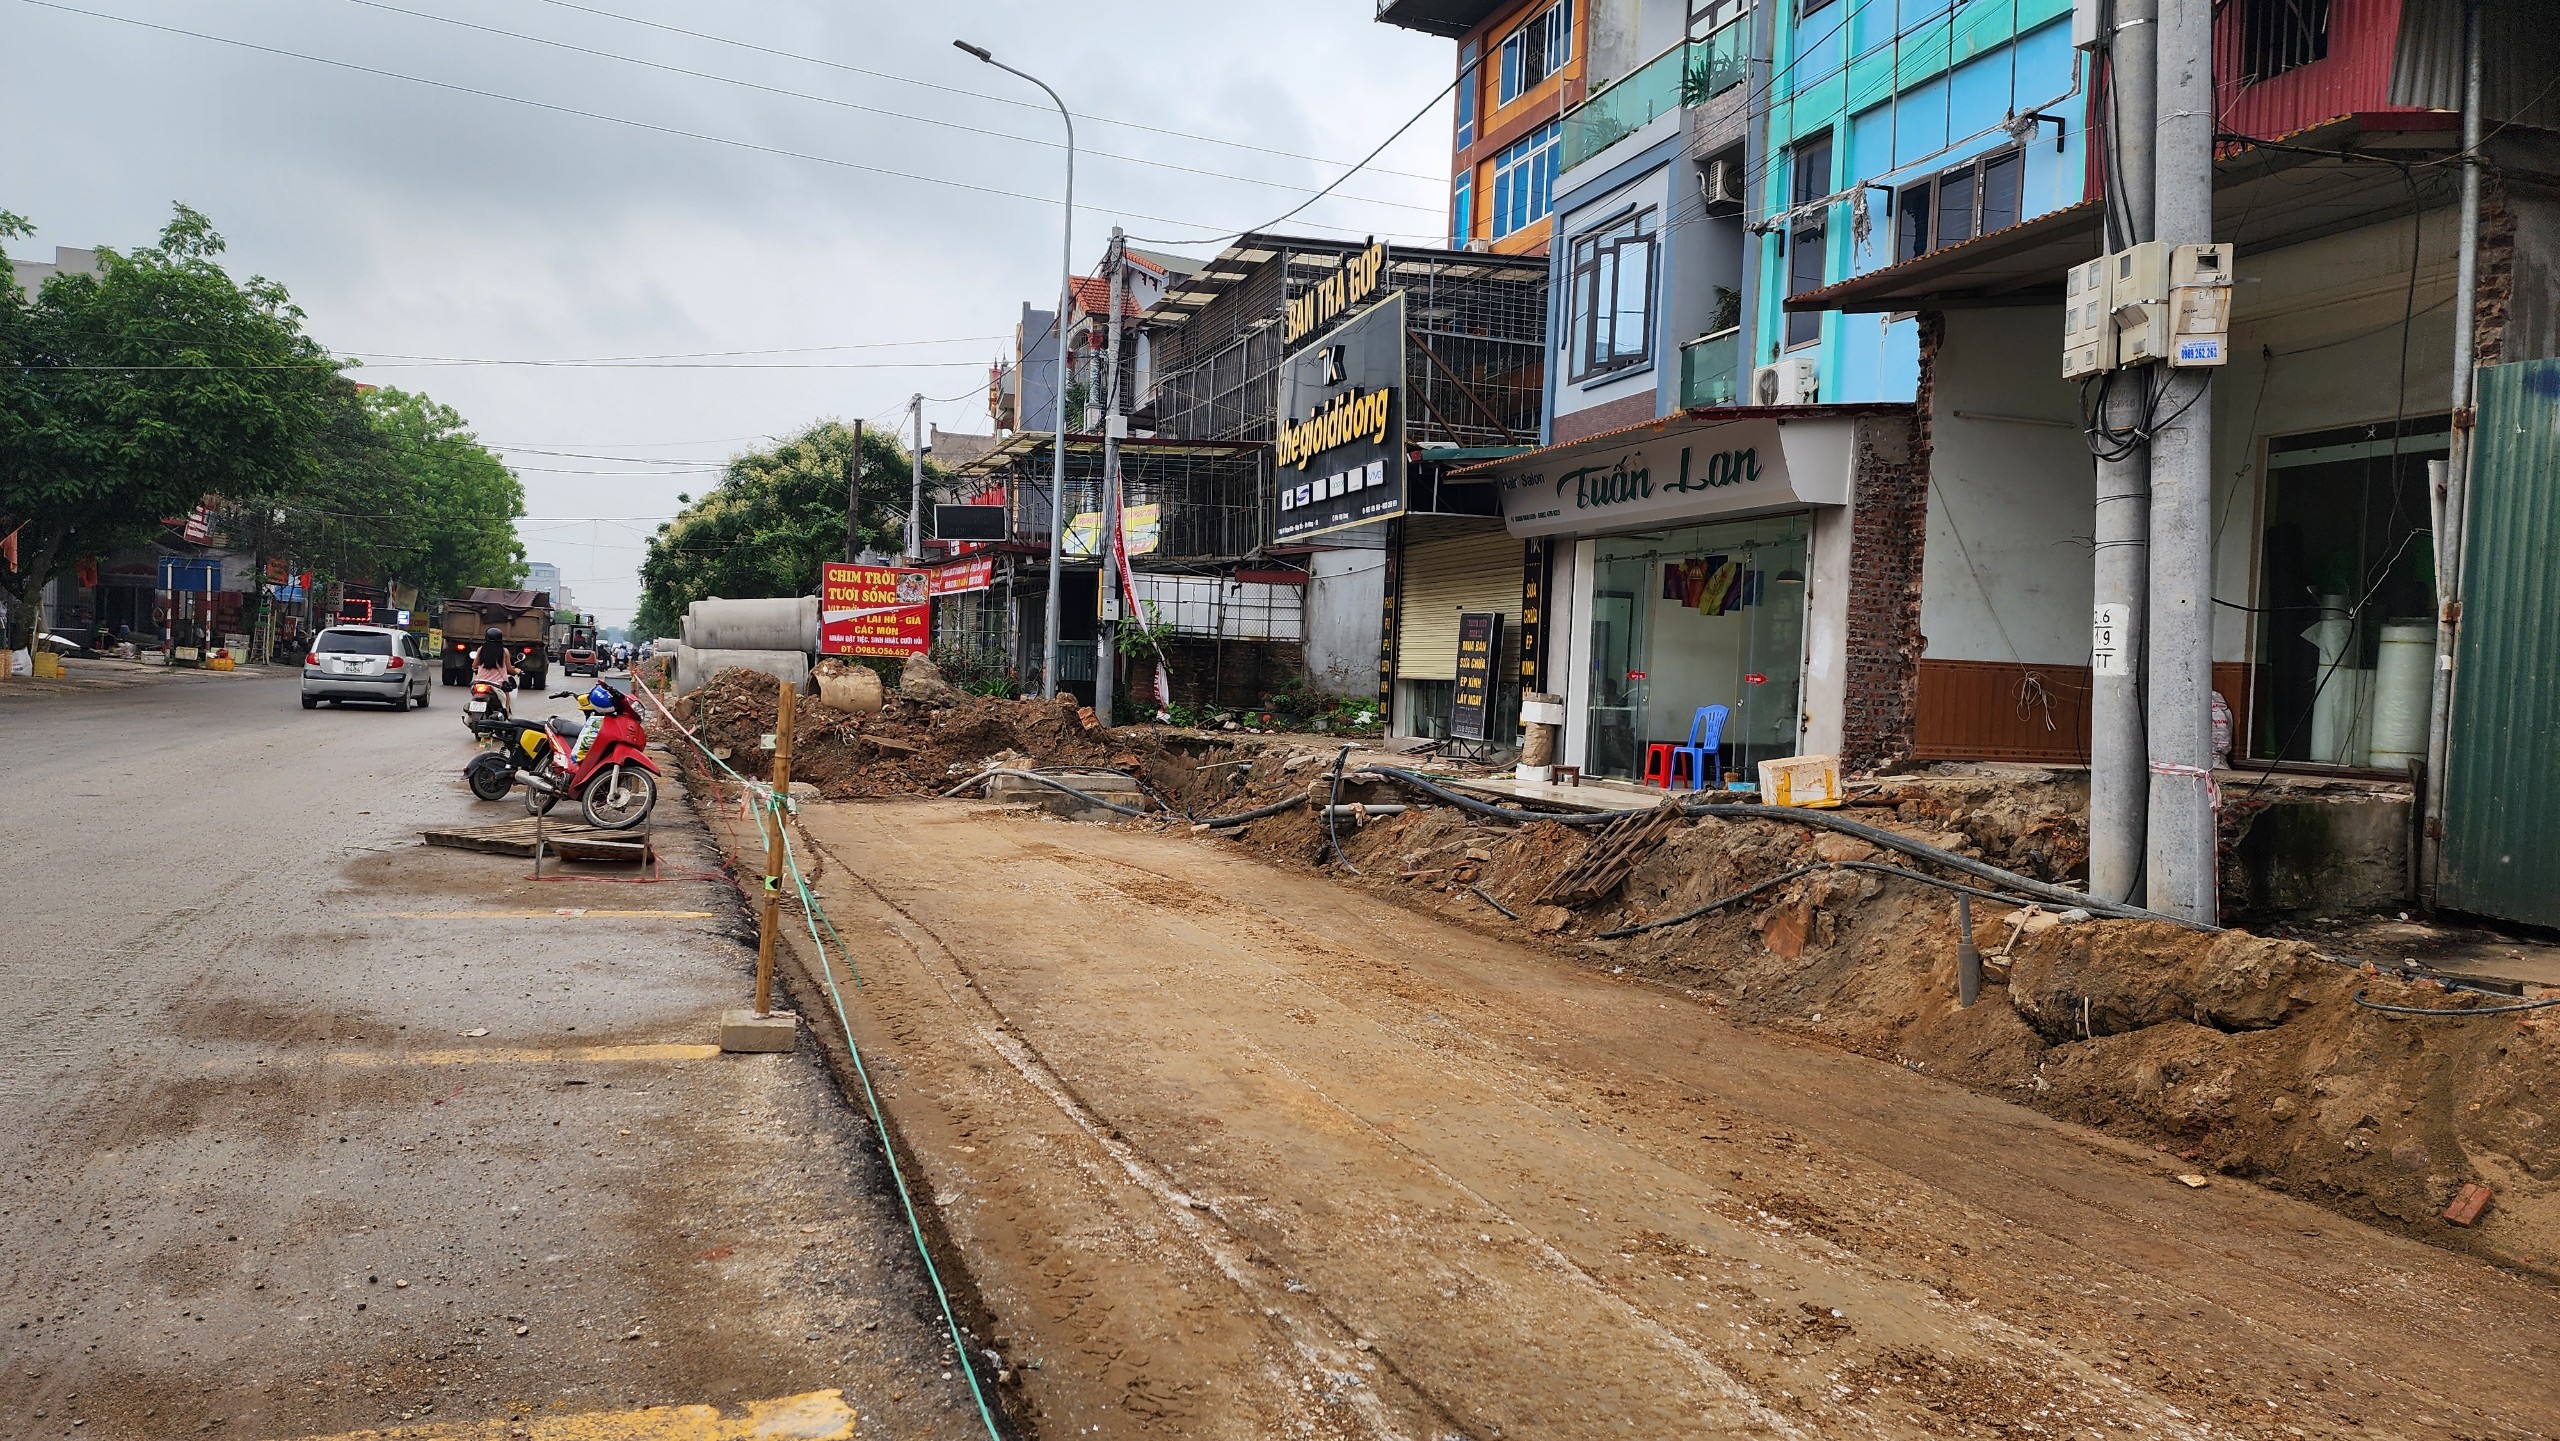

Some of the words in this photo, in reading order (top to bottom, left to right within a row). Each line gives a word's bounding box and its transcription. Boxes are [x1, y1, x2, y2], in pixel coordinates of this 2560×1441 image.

[1288, 284, 1315, 345] BÁN
[1348, 234, 1384, 304] GÓP
[1278, 387, 1390, 471] thegioididong
[1367, 470, 1382, 481] vivo
[1501, 476, 1518, 491] Hair
[1520, 471, 1546, 488] Salon
[1556, 454, 1656, 510] Tuấn
[1662, 446, 1764, 494] Lan
[828, 569, 862, 583] CHIM
[864, 569, 896, 586] TRỜI
[828, 586, 860, 602] TƯƠI
[861, 585, 896, 604] SỐNG
[1526, 578, 1538, 599] SỬA
[866, 615, 882, 624] LAI
[1523, 606, 1538, 625] CHỮA
[854, 625, 874, 635] CÁC
[876, 626, 899, 636] MÓN
[870, 636, 884, 644] SINH
[1462, 640, 1475, 652] MUA
[1475, 638, 1487, 652] BÁN
[1525, 632, 1533, 650] ÉP
[840, 645, 854, 654] ĐT:
[855, 646, 910, 656] 0985.056.652
[1459, 654, 1471, 669] SỬA
[1471, 656, 1486, 670] CHỮA
[1521, 658, 1535, 676] KÍNH
[2095, 653, 2114, 669] TT
[1459, 674, 1468, 687] ÉP
[1468, 675, 1482, 689] KÍNH
[1456, 690, 1468, 705] LẤY
[1468, 694, 1483, 707] NGAY
